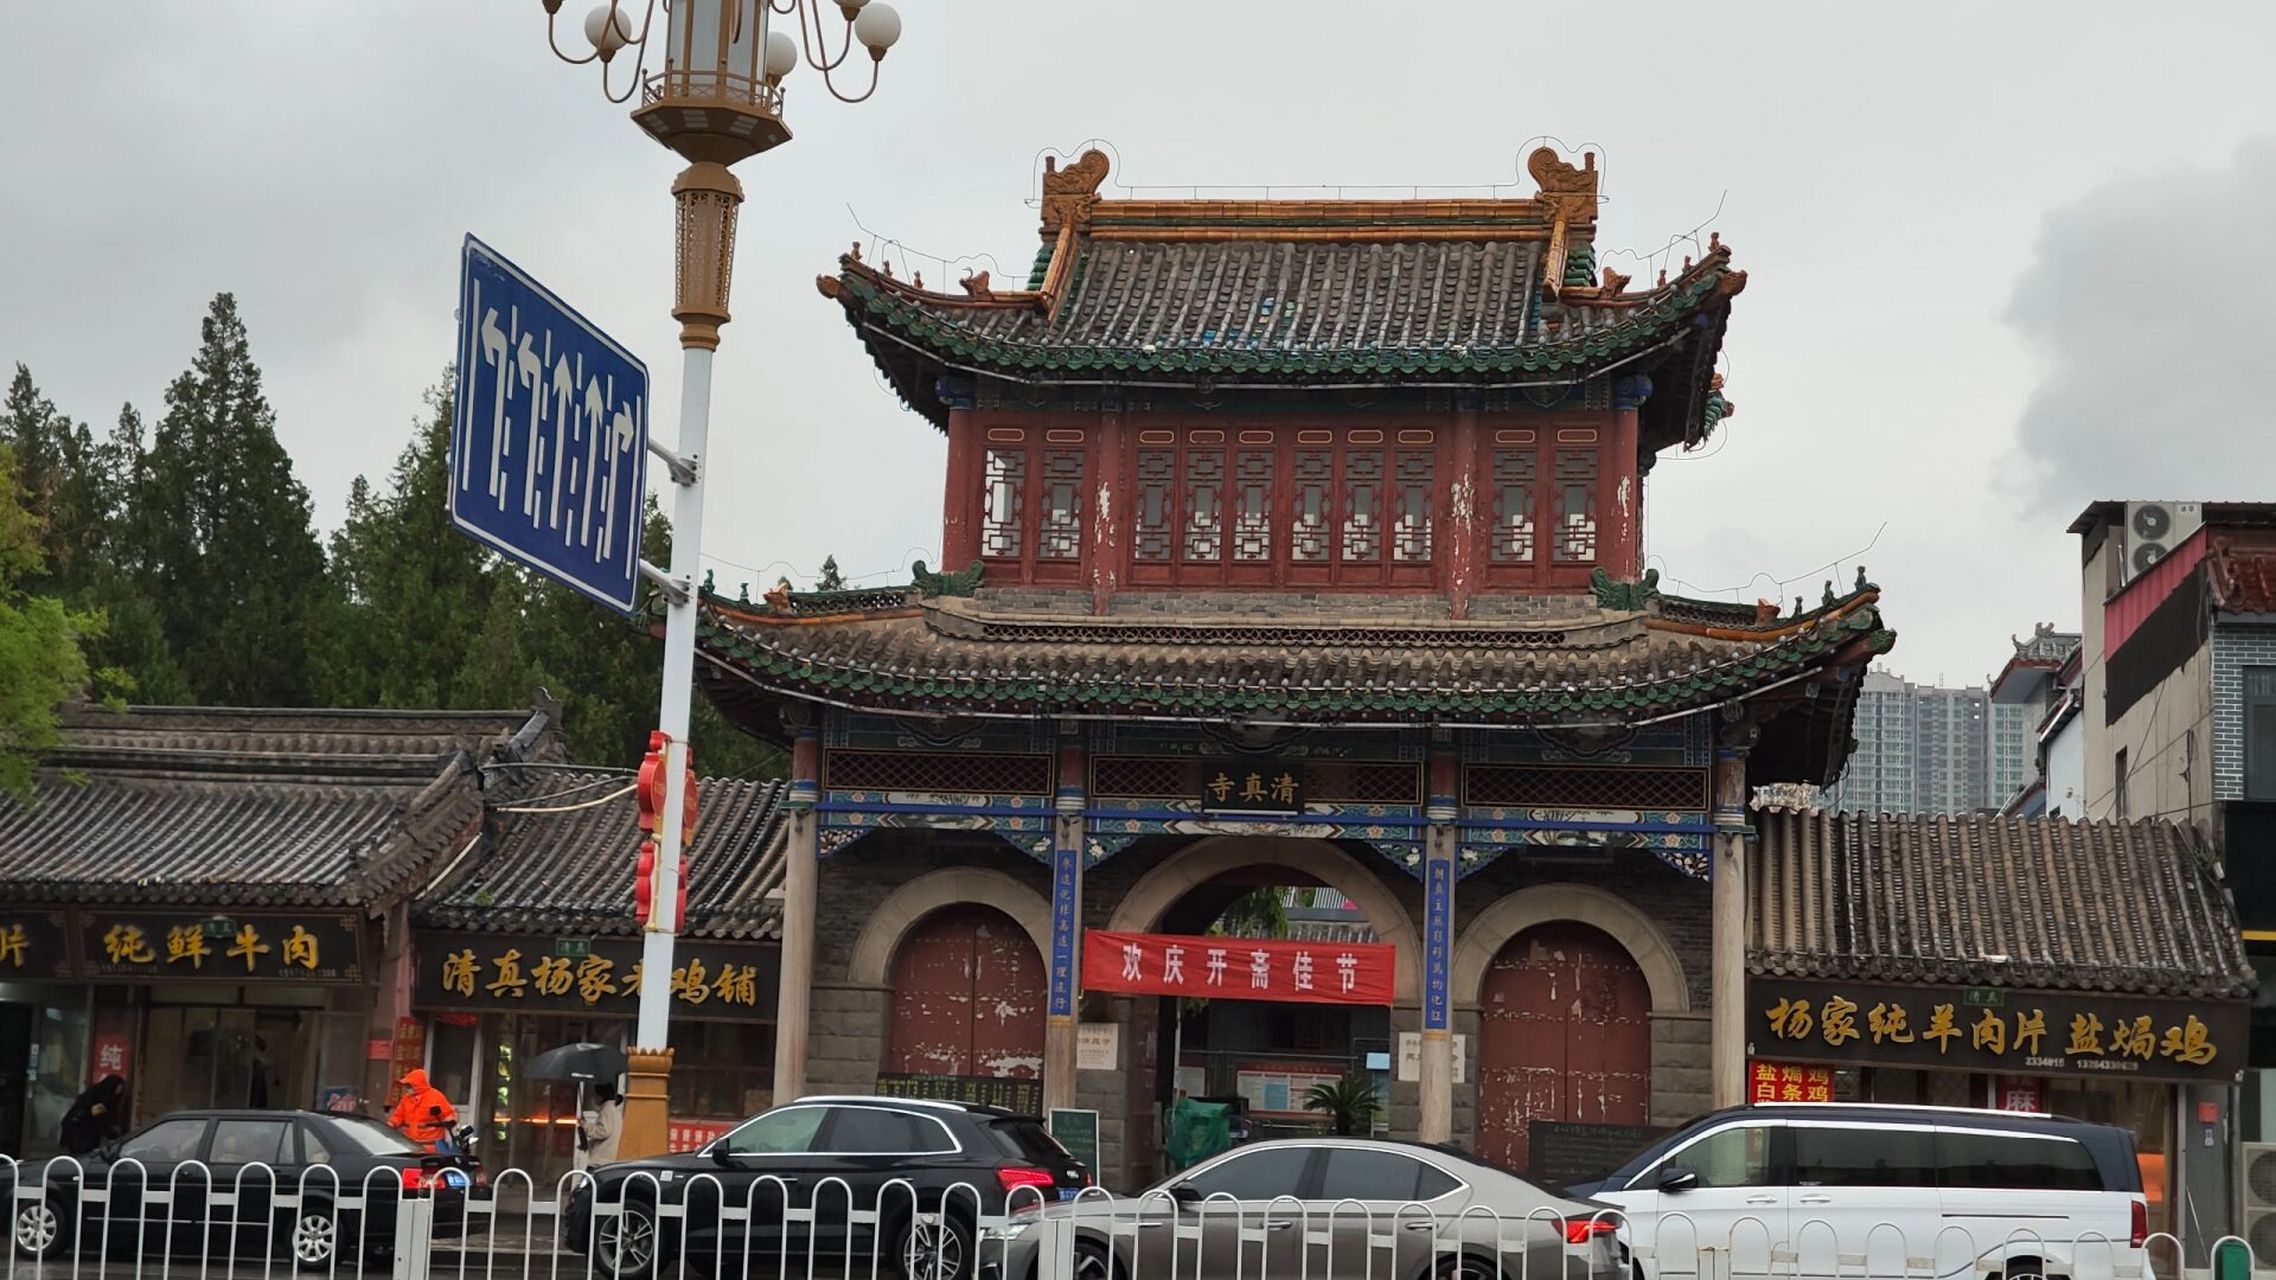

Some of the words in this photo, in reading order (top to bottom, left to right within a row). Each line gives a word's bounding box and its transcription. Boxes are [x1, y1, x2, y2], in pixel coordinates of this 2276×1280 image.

[1121, 942, 1358, 994] 欢庆开斋佳节
[1764, 995, 2048, 1056] 杨家纯羊肉片
[2065, 1013, 2218, 1066] 盐焗鸡
[99, 1044, 124, 1071] 纯
[1756, 1064, 1829, 1086] 盐焗鸡
[1757, 1082, 1829, 1102] 白条鸡
